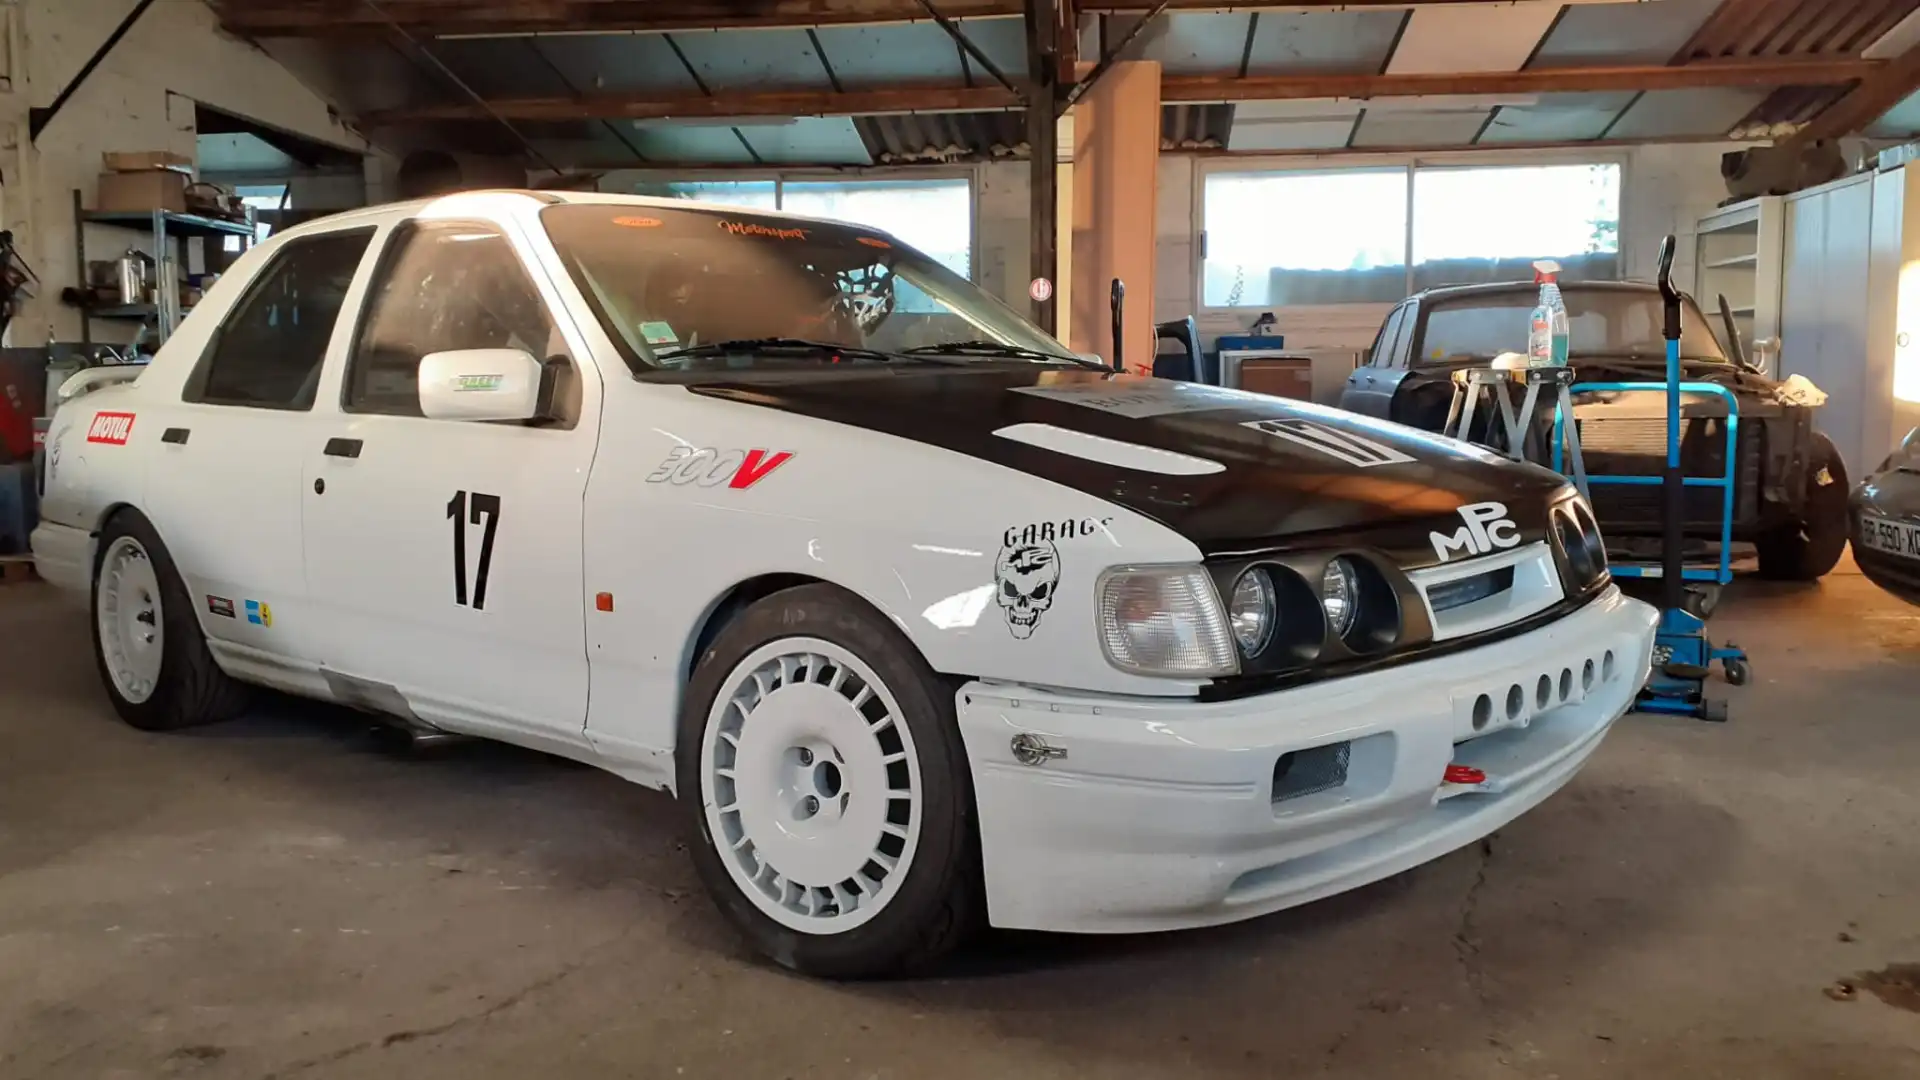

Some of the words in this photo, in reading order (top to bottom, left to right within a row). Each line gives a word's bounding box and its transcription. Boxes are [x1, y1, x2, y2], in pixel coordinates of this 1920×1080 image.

[89, 415, 132, 440] MOTUL
[645, 446, 796, 490] 300V
[446, 490, 501, 610] 17
